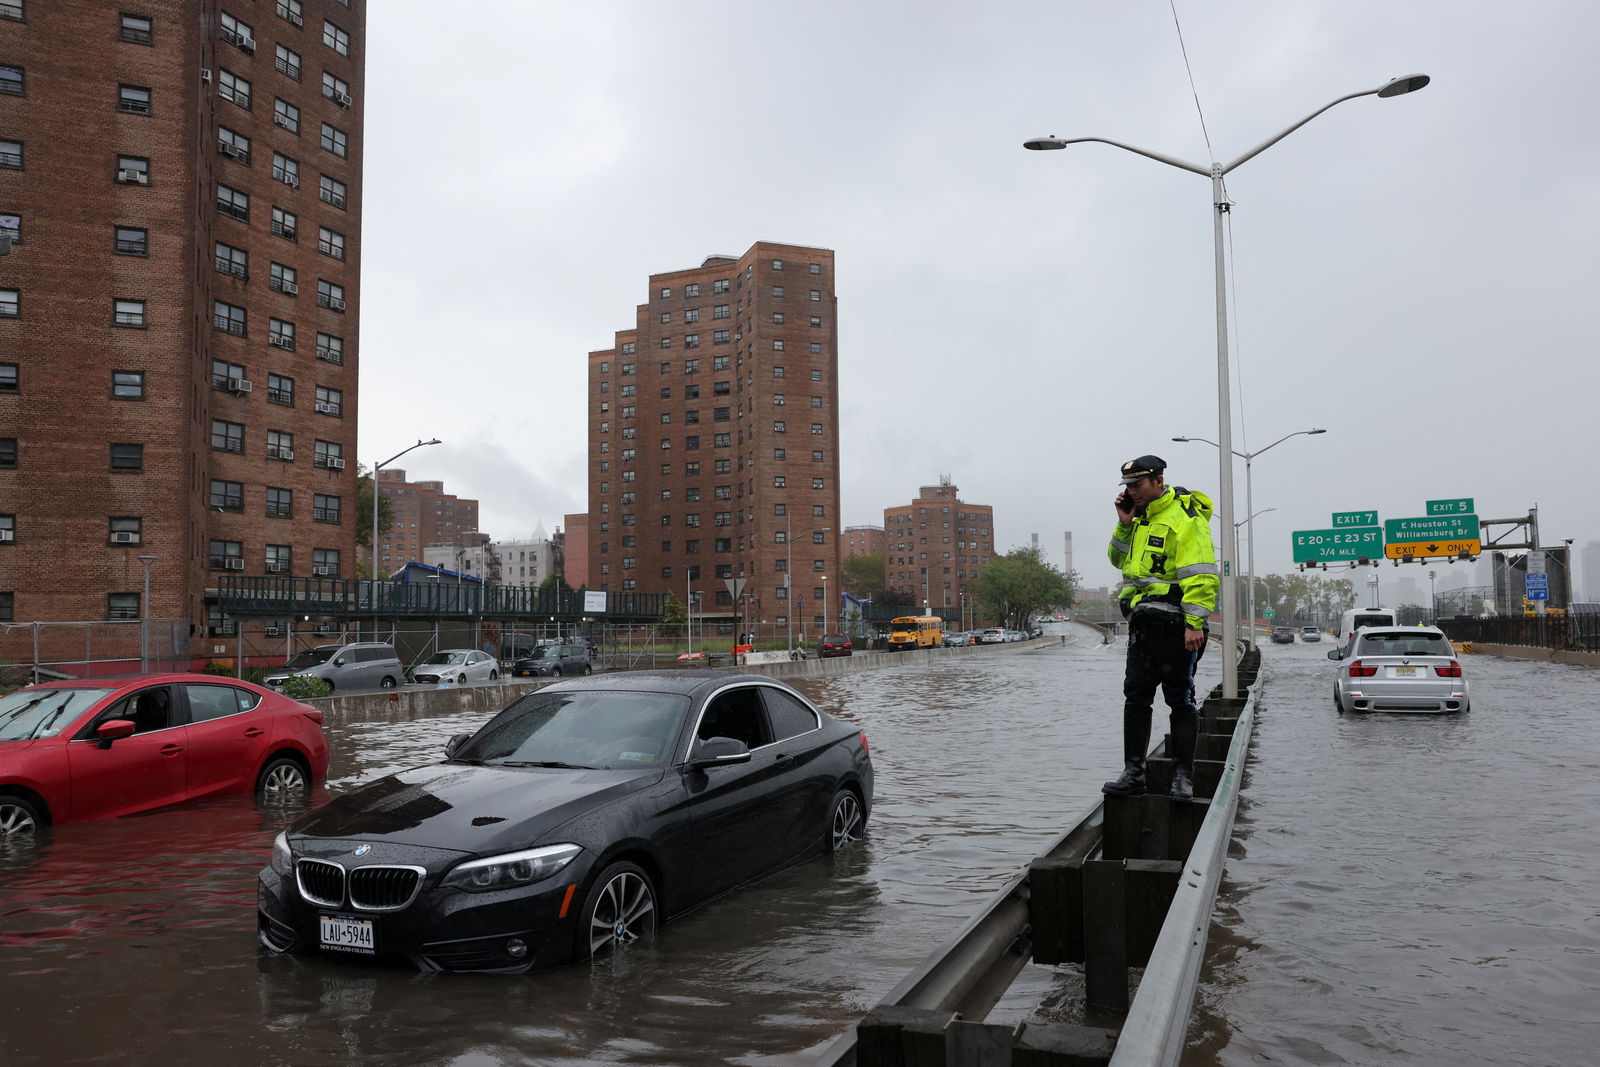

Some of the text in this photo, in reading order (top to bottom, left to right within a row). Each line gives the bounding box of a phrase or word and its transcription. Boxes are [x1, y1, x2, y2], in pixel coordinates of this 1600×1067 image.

[1433, 501, 1467, 512] EXIT 5
[1337, 513, 1373, 524] EXIT 7
[1411, 520, 1448, 528] Houston
[1298, 537, 1305, 545] E
[1308, 535, 1323, 545] 20
[1334, 535, 1341, 544] E
[1345, 534, 1360, 543] 23
[1363, 532, 1377, 542] ST
[1396, 528, 1468, 538] Williamsburg Br
[1319, 547, 1335, 556] 3/4
[1395, 543, 1473, 554] EXIT ONLY
